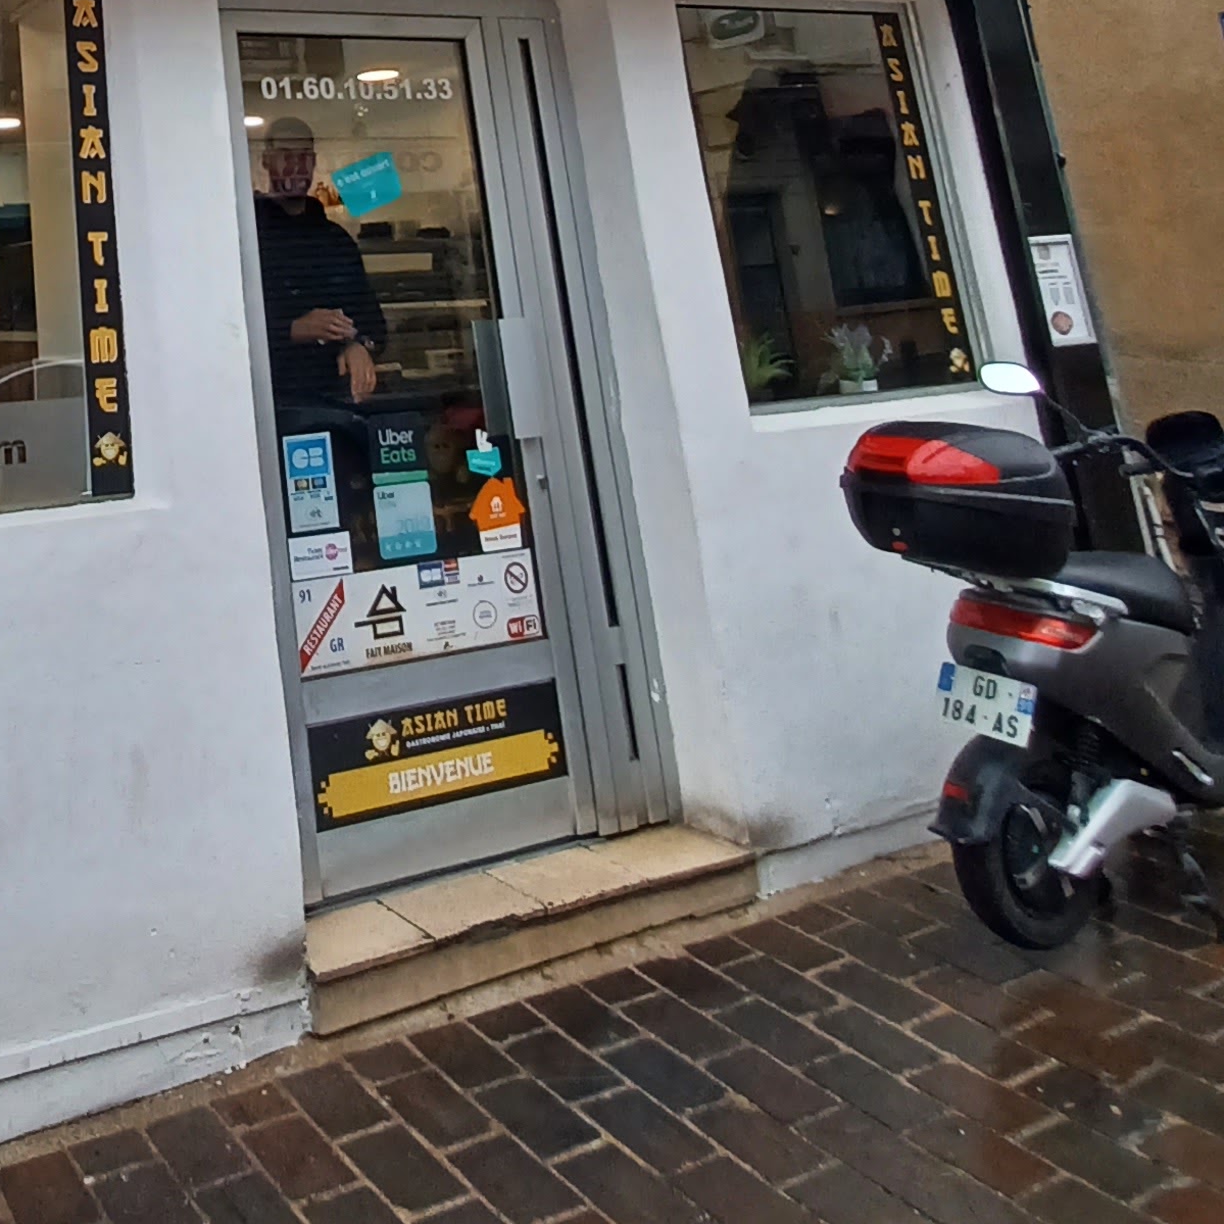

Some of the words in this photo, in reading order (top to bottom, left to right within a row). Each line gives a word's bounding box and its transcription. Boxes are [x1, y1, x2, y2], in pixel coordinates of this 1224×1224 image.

[260, 76, 454, 100] 01.60.10.51.33
[880, 22, 926, 180] ASIAN
[918, 198, 960, 335] TIME
[88, 231, 119, 413] TIME
[378, 429, 414, 447] Uber
[380, 447, 417, 464] Eats
[299, 588, 312, 604] 91
[302, 593, 344, 656] RESTAURANT
[329, 637, 345, 653] GR
[365, 644, 382, 659] FAIT
[383, 642, 414, 657] MAISON
[401, 707, 459, 737] ASIAN
[464, 698, 508, 725] TIME
[388, 751, 495, 794] BIENVENUE
